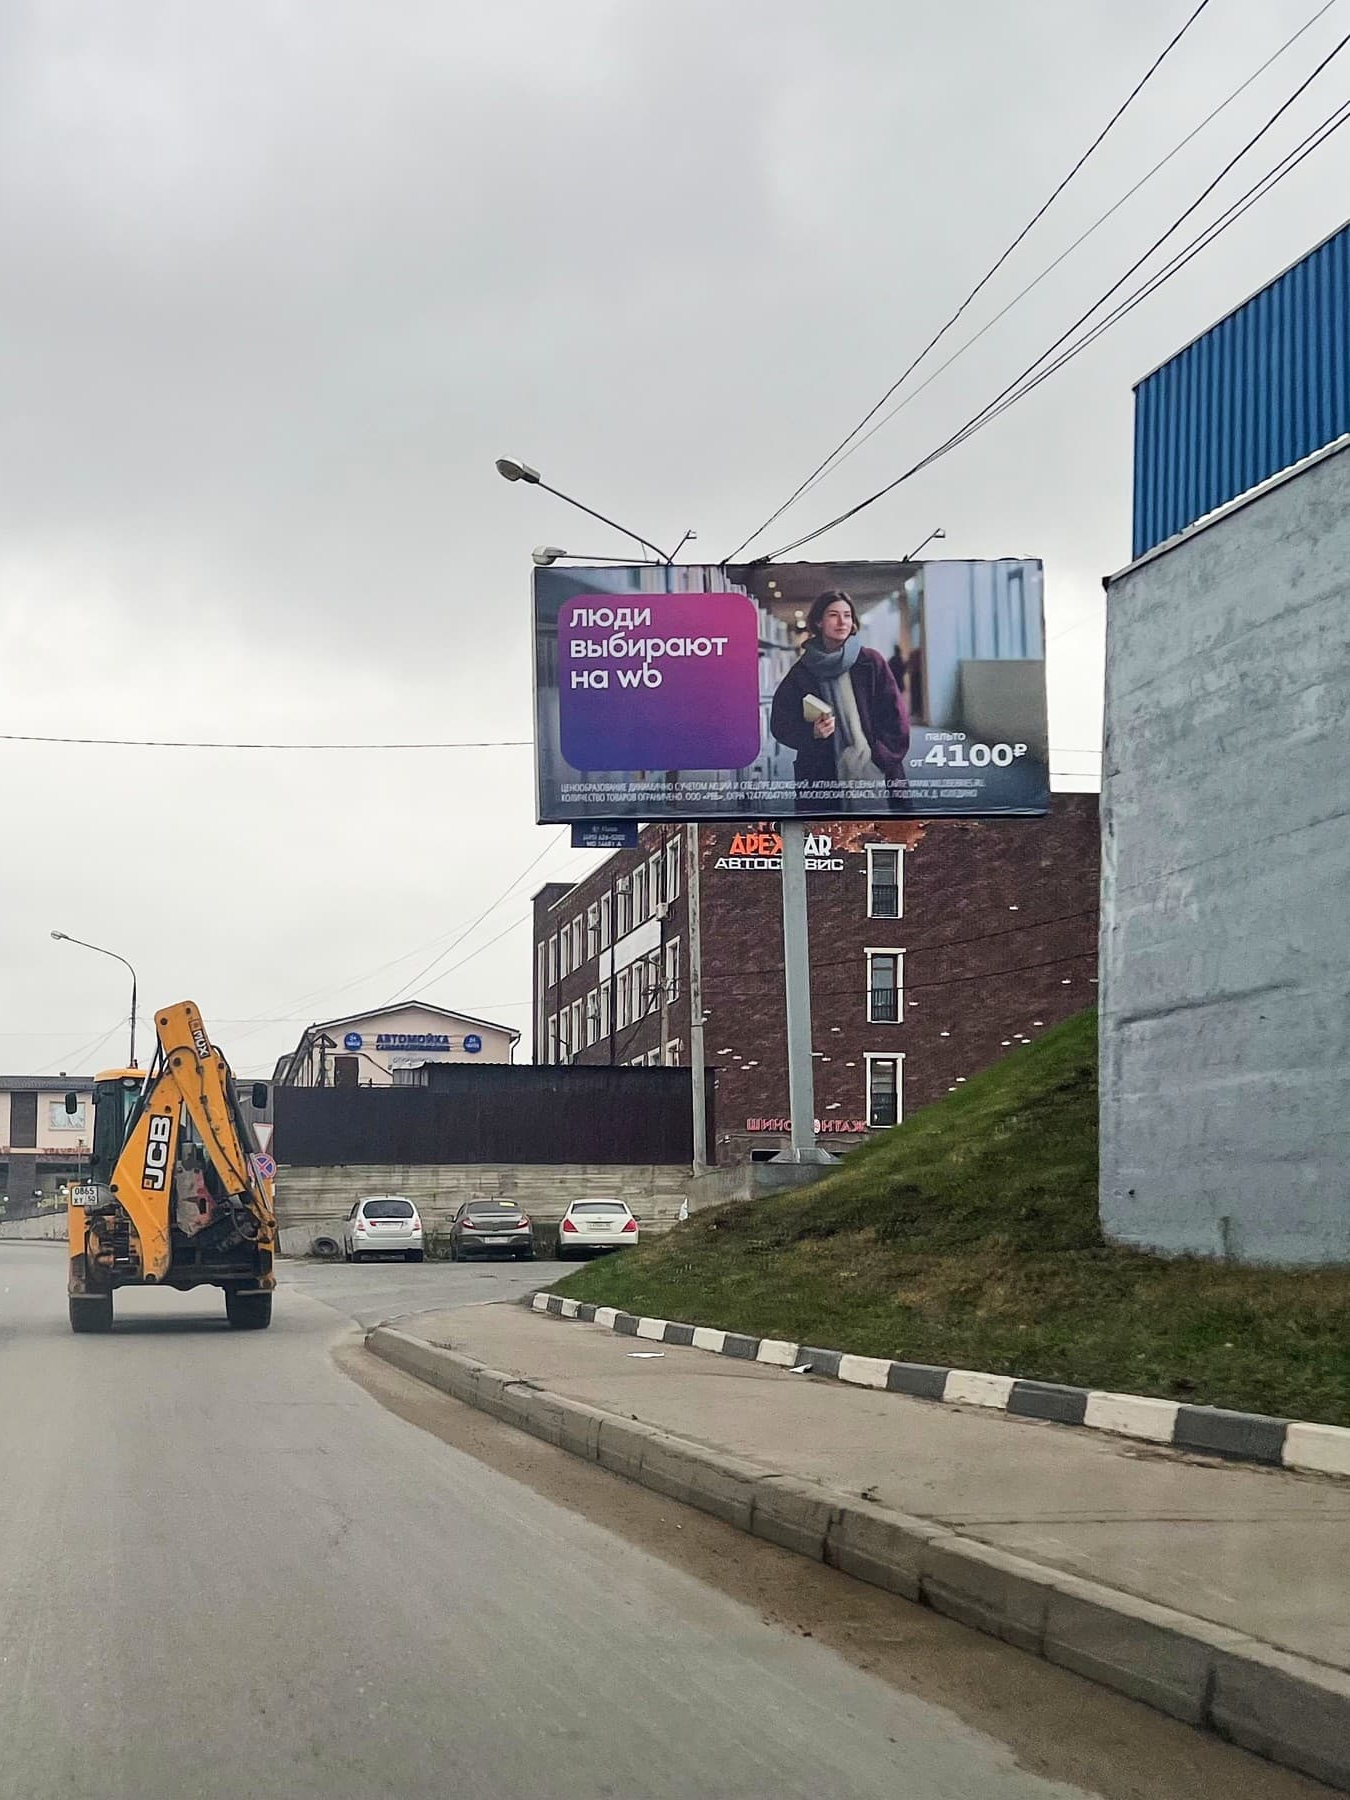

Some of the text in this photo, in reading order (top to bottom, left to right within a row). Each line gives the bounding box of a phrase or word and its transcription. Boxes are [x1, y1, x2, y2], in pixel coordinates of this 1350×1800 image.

[569, 608, 651, 630] люди
[570, 632, 729, 663] выбирают
[571, 662, 663, 689] на wb
[925, 732, 967, 741] пальто
[910, 759, 924, 767] от
[714, 857, 844, 871] АВТОСВИС
[746, 1118, 867, 1133] ШИНООНТАЖ
[145, 1116, 172, 1190] JCB
